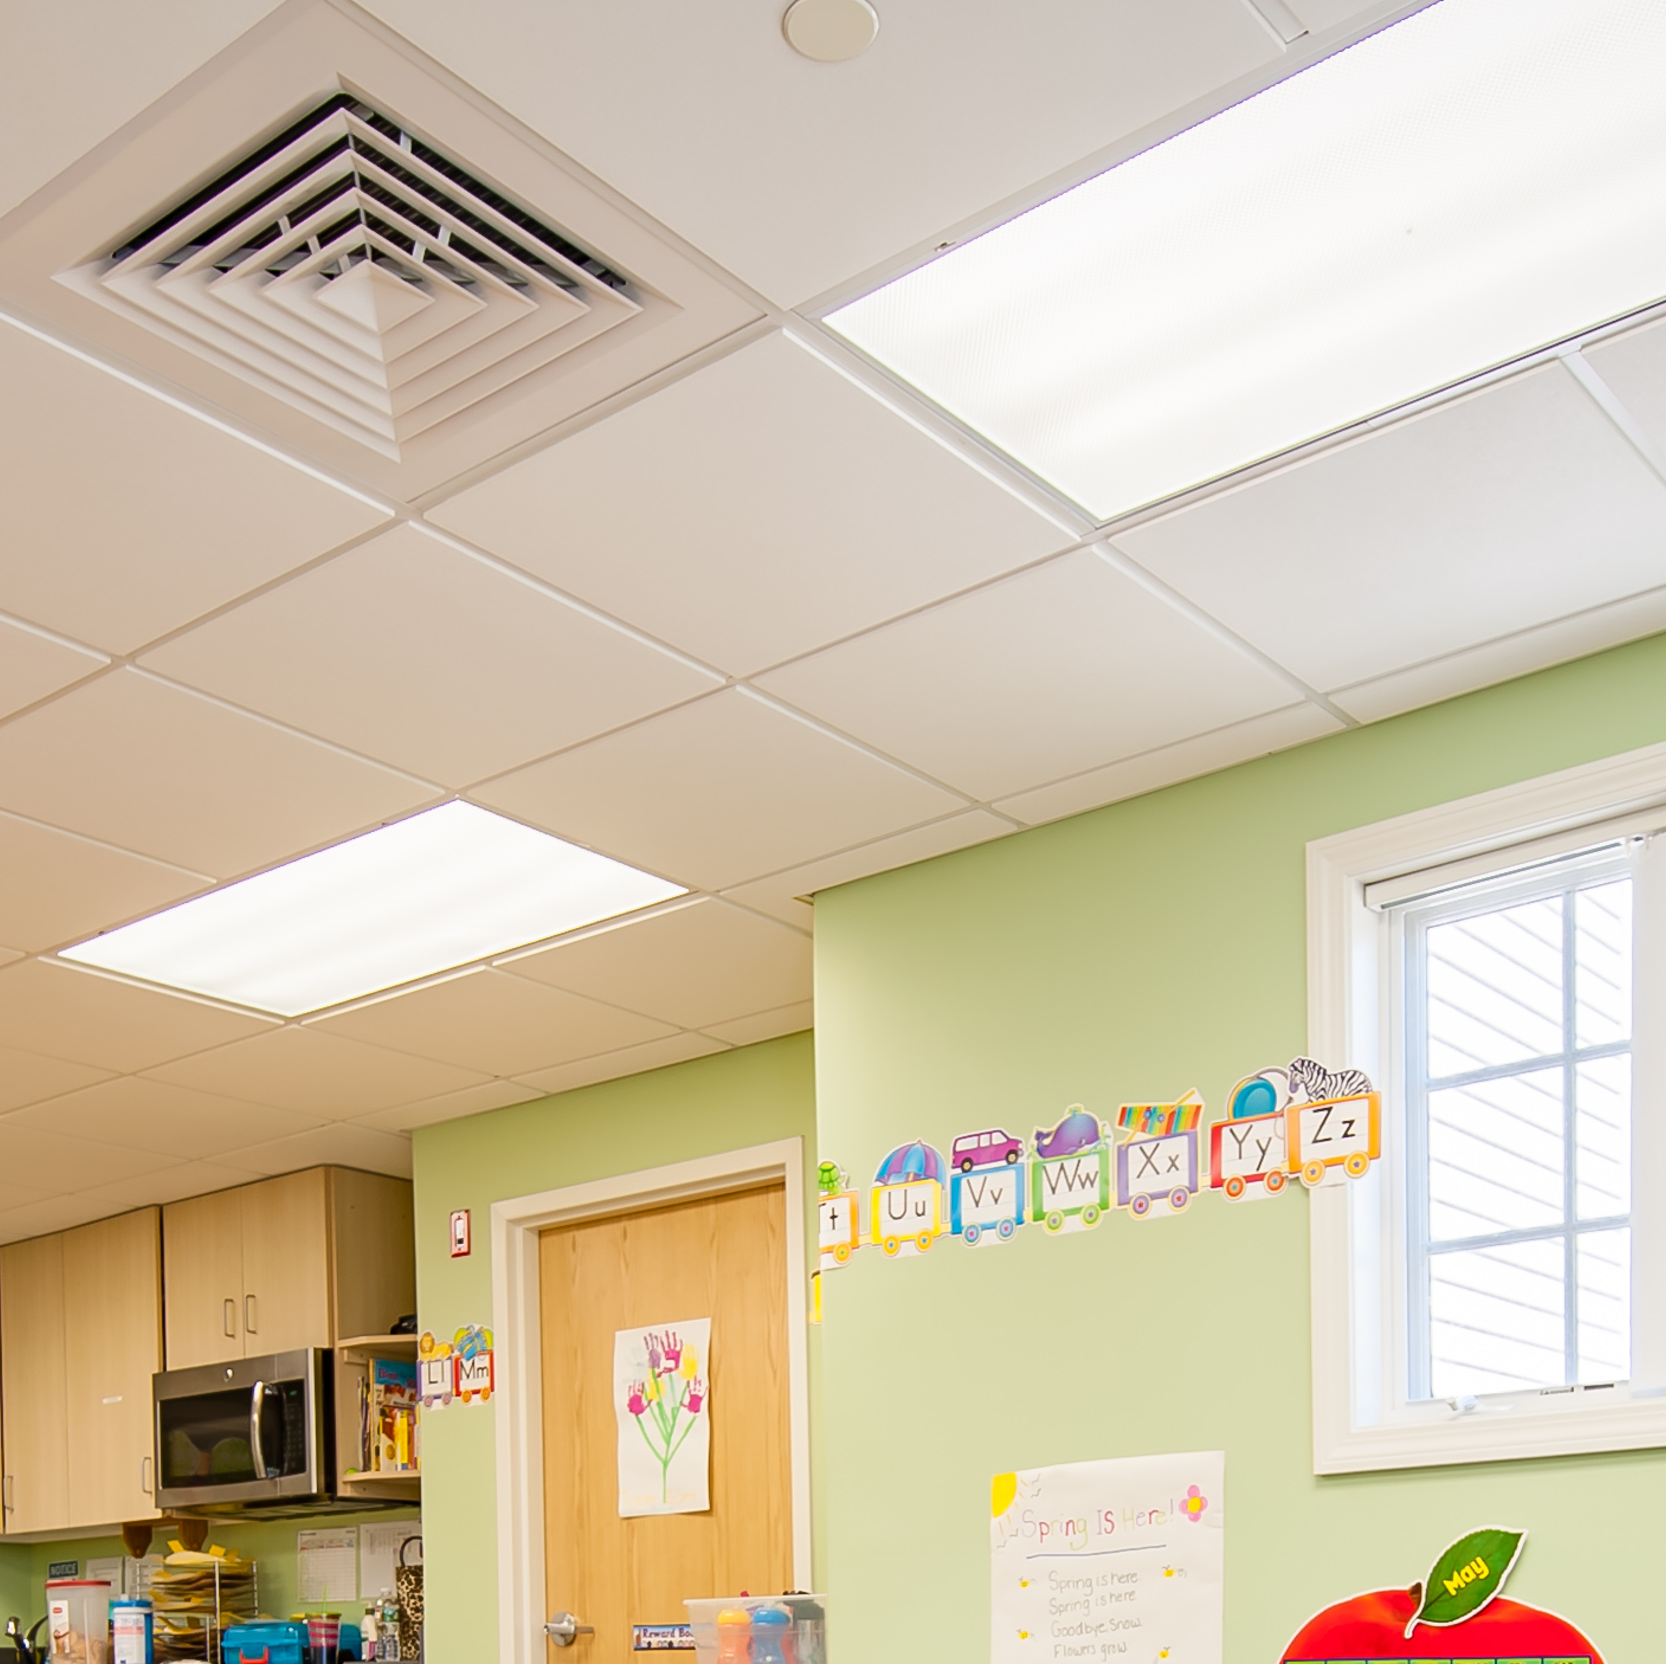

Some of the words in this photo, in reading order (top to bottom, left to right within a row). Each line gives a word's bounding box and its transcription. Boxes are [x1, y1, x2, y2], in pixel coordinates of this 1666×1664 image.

[1311, 1107, 1356, 1145] Zz
[1136, 1143, 1181, 1179] Xx
[1229, 1124, 1270, 1172] Yy
[967, 1176, 1003, 1208] Vv
[1042, 1160, 1099, 1196] Ww
[887, 1190, 926, 1220] Uu
[460, 1358, 489, 1381] Mm
[1022, 1509, 1089, 1551] Spring
[1122, 1499, 1174, 1532] Here!
[50, 1562, 78, 1577] NOTICE
[1048, 1570, 1093, 1597] Spring
[1096, 1573, 1109, 1587] is
[1443, 1556, 1490, 1596] May
[1049, 1597, 1090, 1617] Spring
[1095, 1595, 1108, 1607] is
[643, 1628, 676, 1638] Reward
[1054, 1644, 1096, 1659] Flowers
[1100, 1641, 1127, 1662] grow
